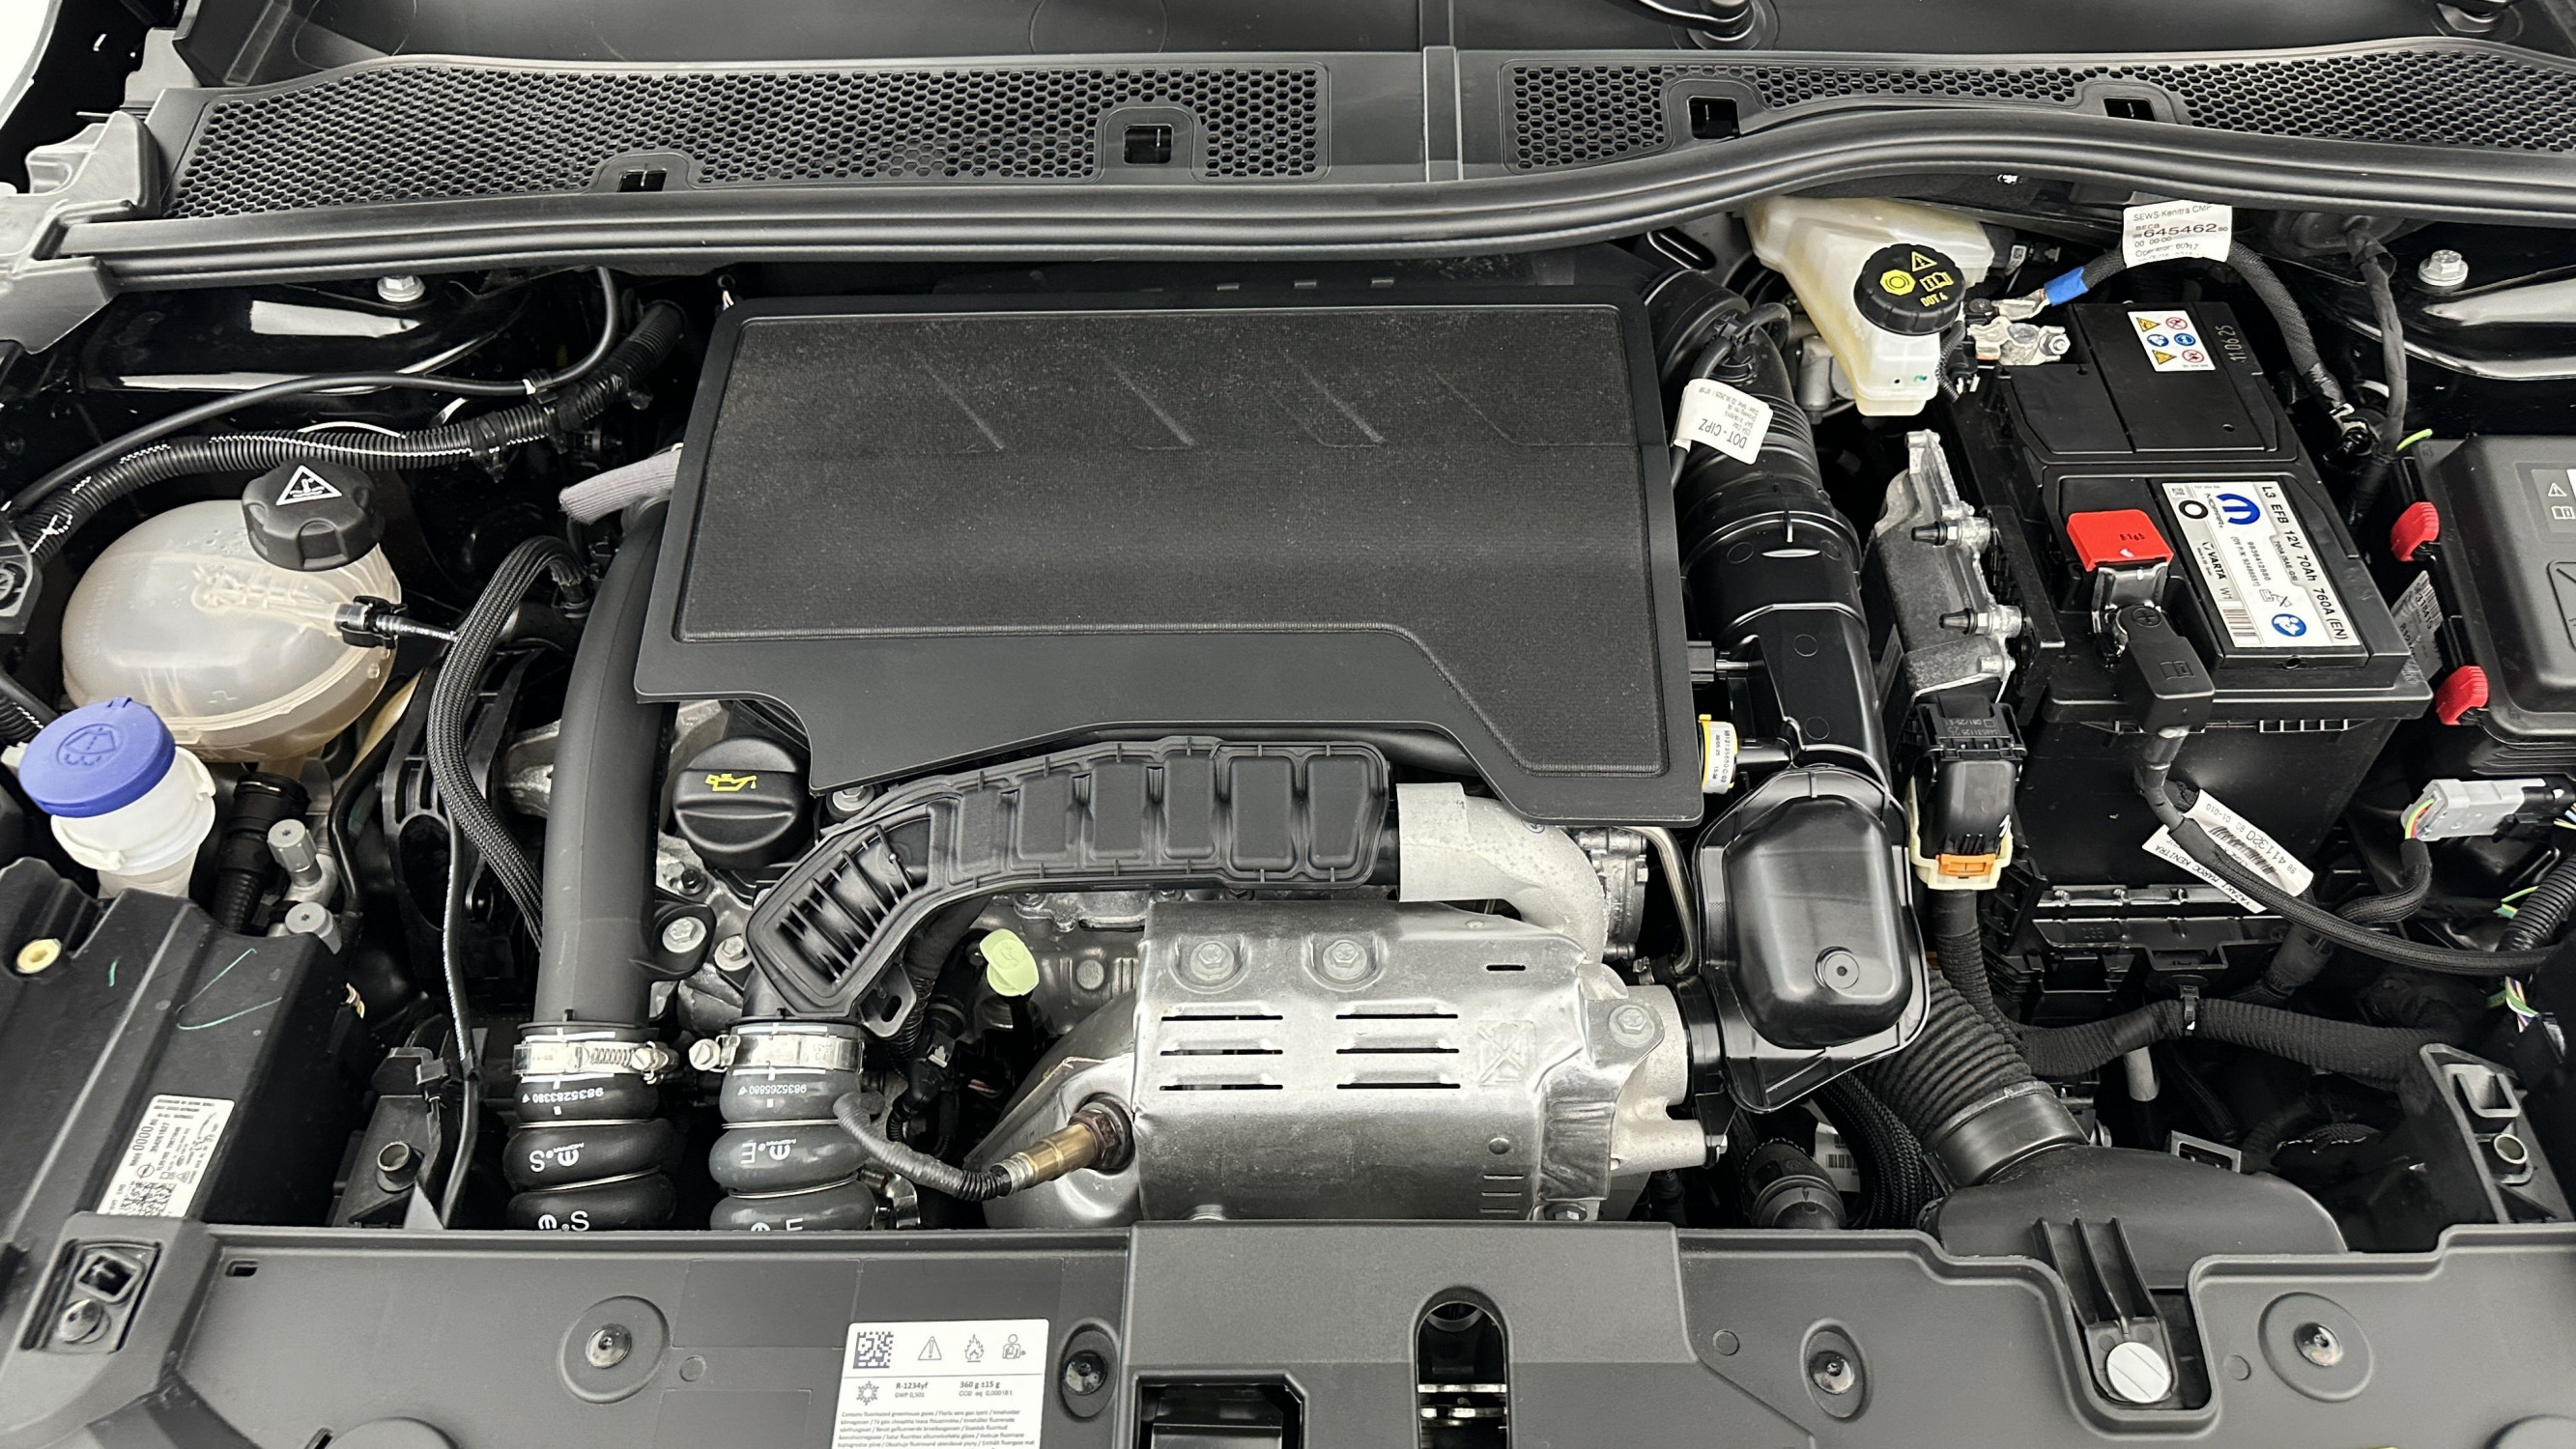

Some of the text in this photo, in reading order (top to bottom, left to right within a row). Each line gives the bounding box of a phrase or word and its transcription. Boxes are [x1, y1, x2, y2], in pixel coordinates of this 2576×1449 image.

[2133, 207, 2190, 222] SEWS-Kenitra
[2143, 223, 2218, 238] 645462
[1920, 292, 1948, 307] DOT 4
[1699, 418, 1722, 437] CIPZ
[1726, 431, 1747, 449] DOT
[2262, 486, 2349, 640] L3 EFB 12V 70Ah 760A (EN)
[2208, 552, 2233, 600] VARTA W1
[2205, 803, 2232, 823] 01-010
[2247, 831, 2287, 865] 411320
[2155, 844, 2250, 906] YAZAKI MAROC KENITRA
[532, 1088, 605, 1103] 9835283380
[749, 1084, 808, 1094] 9835265880
[132, 1125, 154, 1151] 0000
[896, 1381, 929, 1390] R-1234yf
